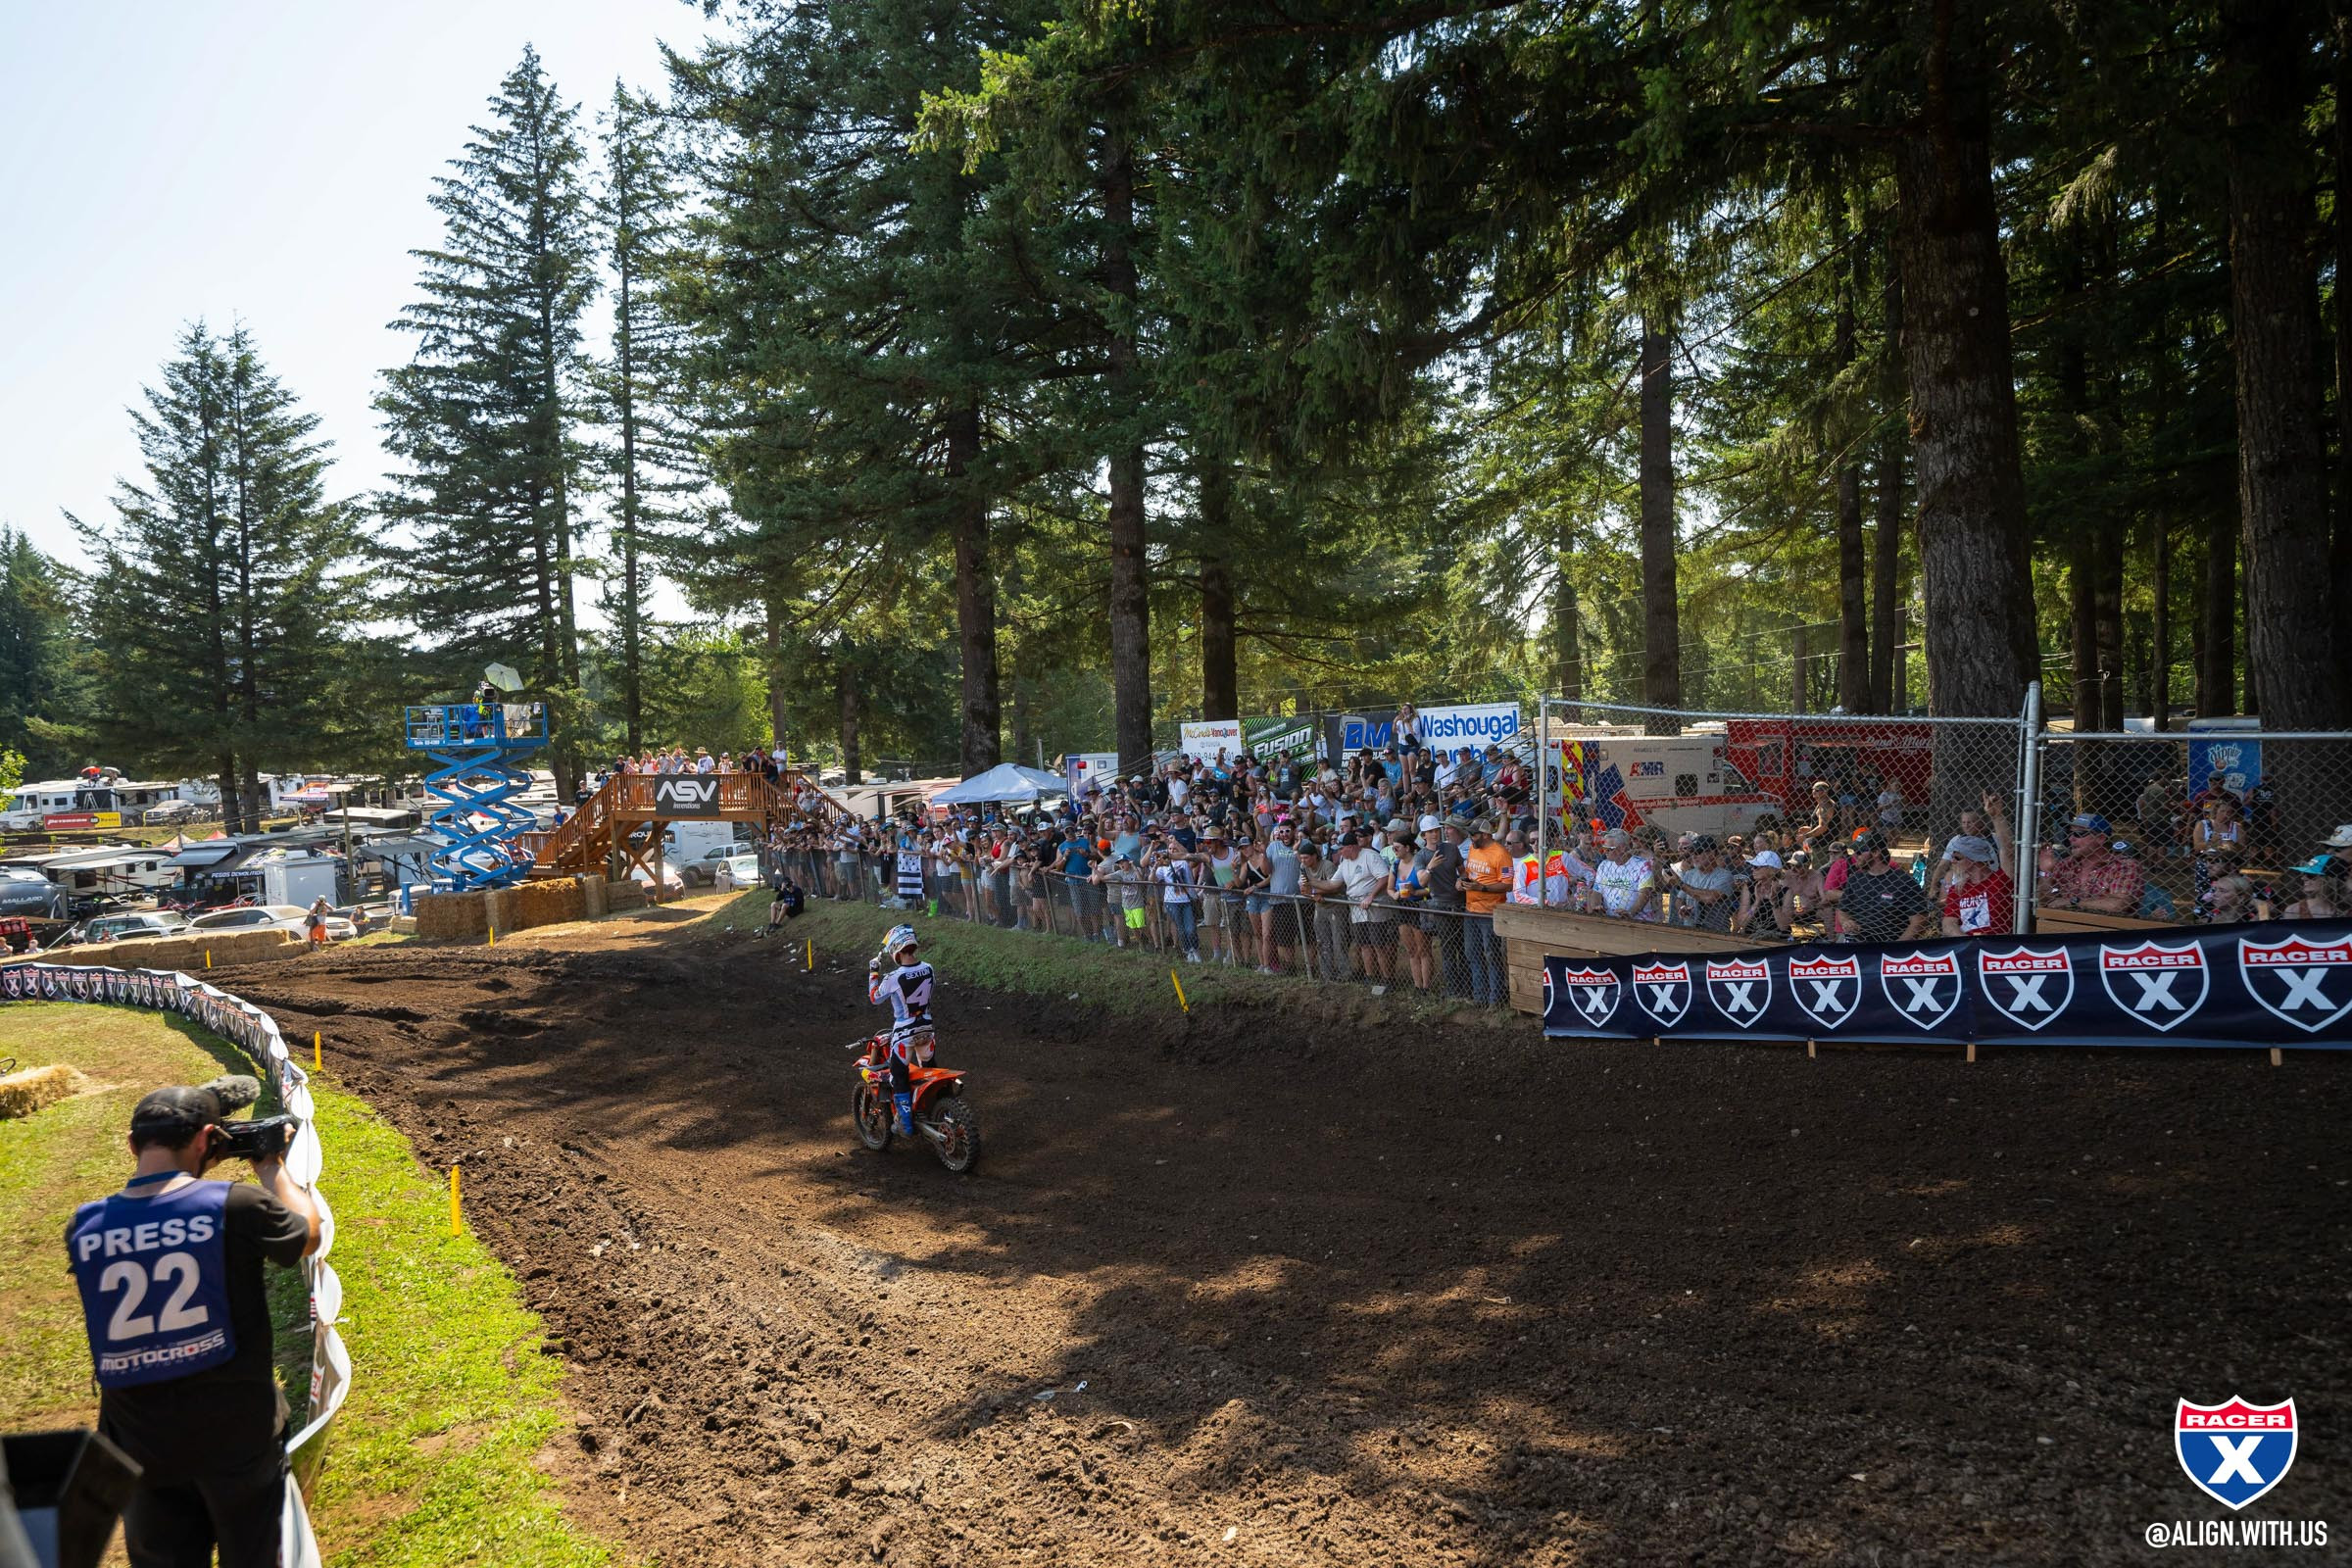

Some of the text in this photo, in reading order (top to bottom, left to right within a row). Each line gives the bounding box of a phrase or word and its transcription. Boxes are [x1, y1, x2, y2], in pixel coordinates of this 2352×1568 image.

[1421, 710, 1518, 742] Washougal
[1629, 760, 1664, 776] AMR
[657, 780, 717, 802] ASV
[1792, 965, 1852, 975] RACER
[1885, 962, 1950, 973] RACER
[1986, 958, 2063, 970] RACER
[2108, 955, 2195, 967] RACER
[2248, 950, 2348, 962] RACER
[1569, 975, 1612, 984] RACER
[1637, 972, 1684, 981] RACER
[1710, 968, 1763, 978] RACER
[906, 977, 932, 1006] 4
[1582, 986, 1609, 1013] X
[1648, 984, 1680, 1012] X
[1724, 982, 1758, 1012] X
[1808, 979, 1846, 1012] X
[1902, 977, 1945, 1012] X
[2004, 975, 2054, 1011] X
[2129, 971, 2186, 1010] X
[2273, 967, 2338, 1010] X
[78, 1215, 215, 1262] PRESS
[99, 1251, 209, 1342] 22
[100, 1333, 226, 1372] MOTOCROSS
